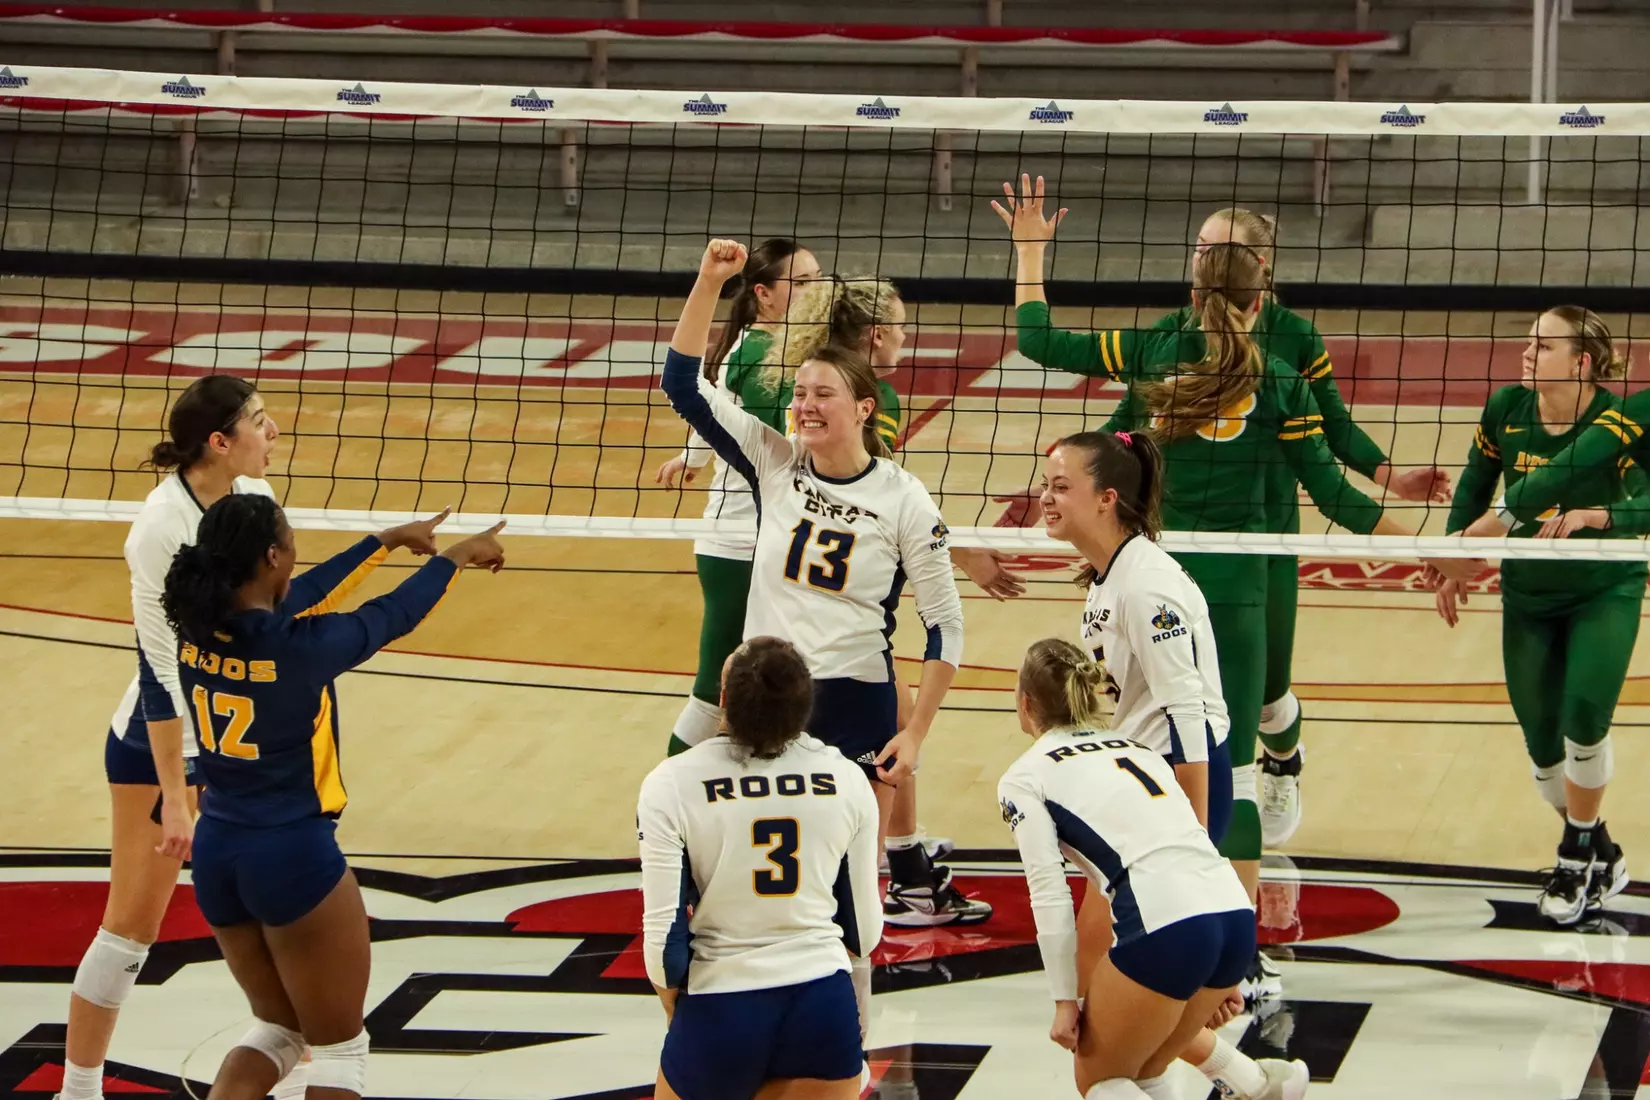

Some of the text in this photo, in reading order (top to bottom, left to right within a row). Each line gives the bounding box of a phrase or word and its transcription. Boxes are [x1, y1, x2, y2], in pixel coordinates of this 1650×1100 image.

[161, 85, 206, 96] SUMMIT
[337, 92, 381, 103] SUMMIT
[510, 98, 554, 109] SUMMIT
[683, 103, 727, 113] SUMMIT
[856, 107, 900, 117] SUMMIT
[1029, 111, 1073, 120] SUMMIT
[1203, 113, 1248, 122] SUMMIT
[1380, 115, 1425, 123] SUMMIT
[1559, 116, 1605, 125] SUMMIT
[784, 517, 856, 594] 13
[1151, 626, 1188, 644] ROOS
[180, 643, 277, 682] ROOS
[192, 684, 260, 760] 12
[1114, 757, 1167, 799] 1
[702, 773, 837, 803] ROOS
[751, 816, 801, 898] 3
